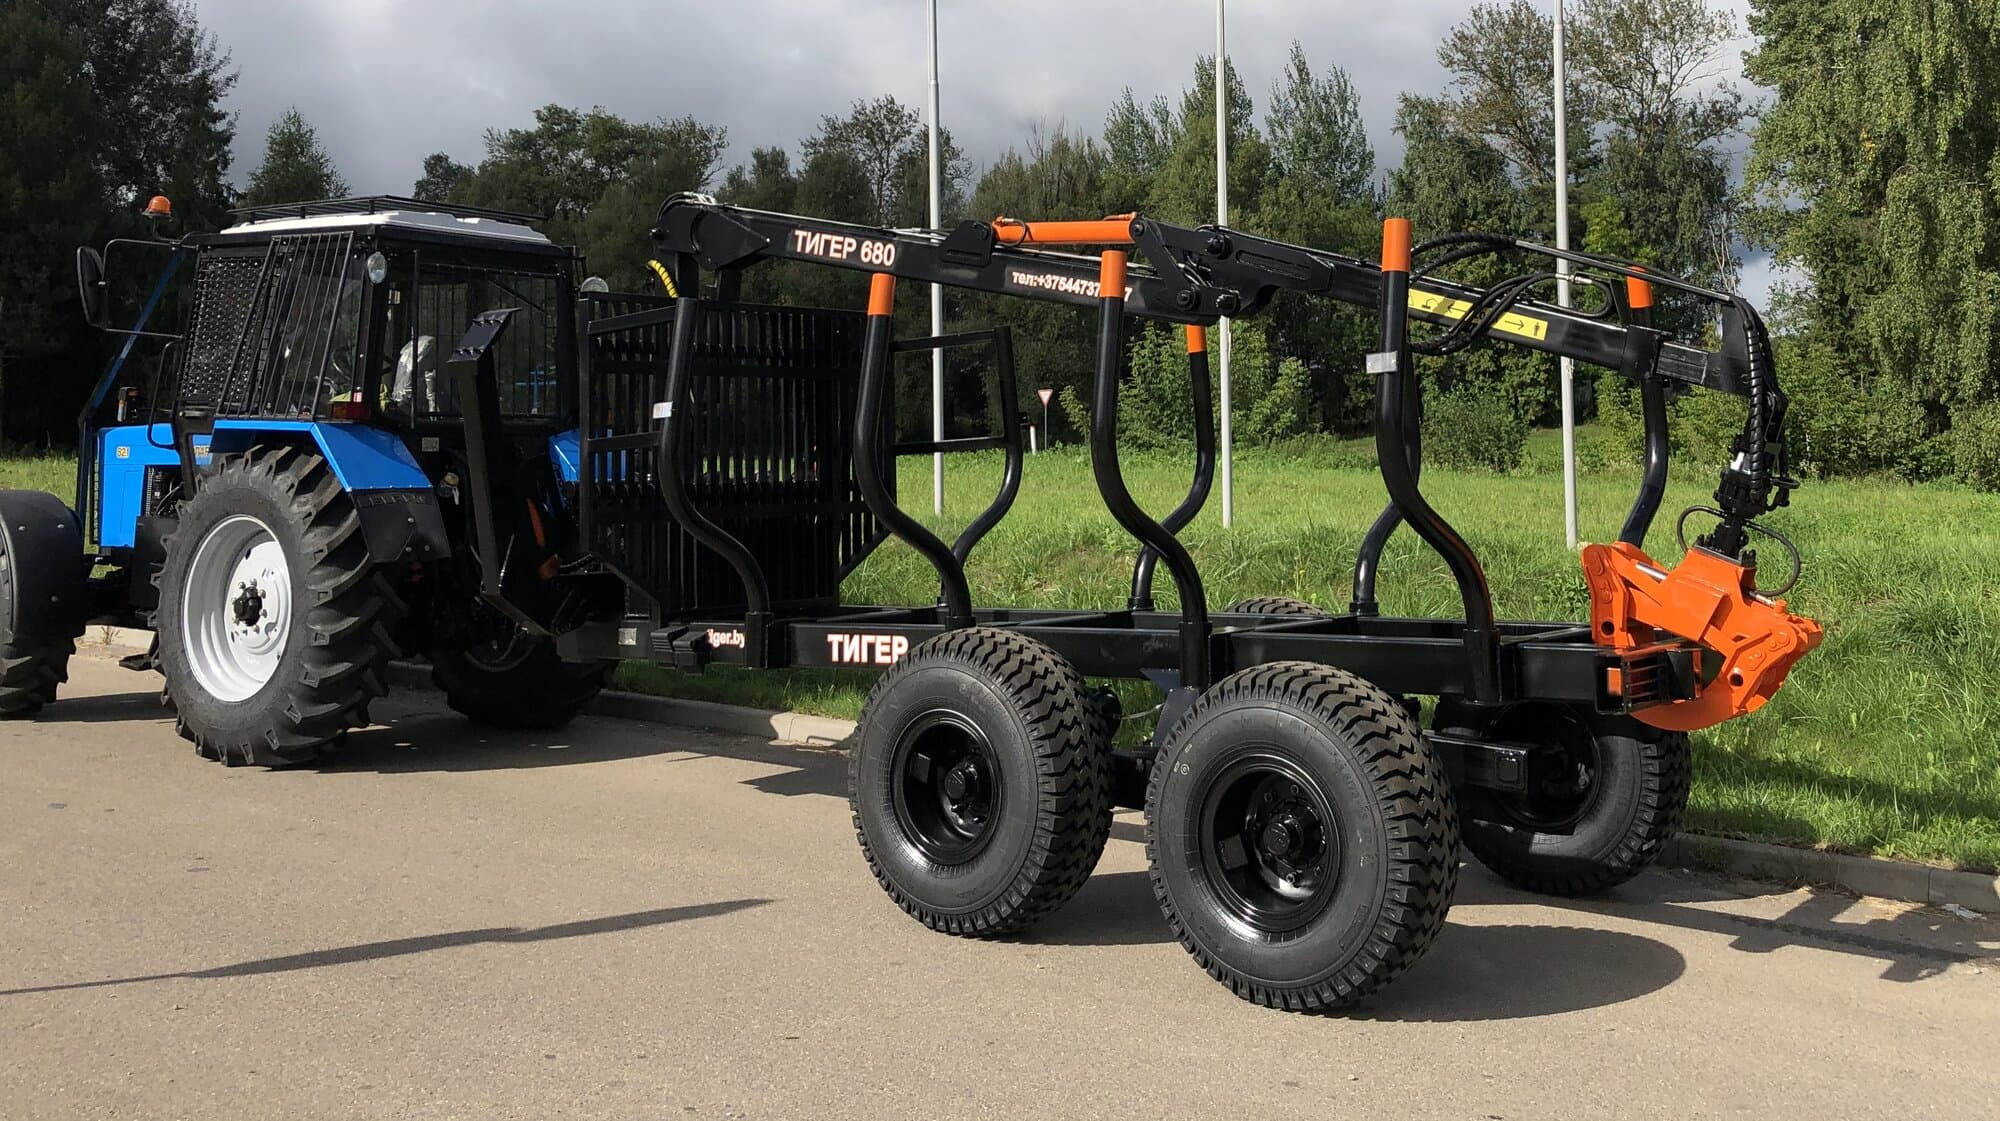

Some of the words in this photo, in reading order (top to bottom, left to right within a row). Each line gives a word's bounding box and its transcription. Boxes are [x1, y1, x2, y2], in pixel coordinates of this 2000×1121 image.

[794, 229, 857, 259] ТИГЕР
[861, 240, 896, 266] 680
[827, 633, 909, 664] ТИГЕР
